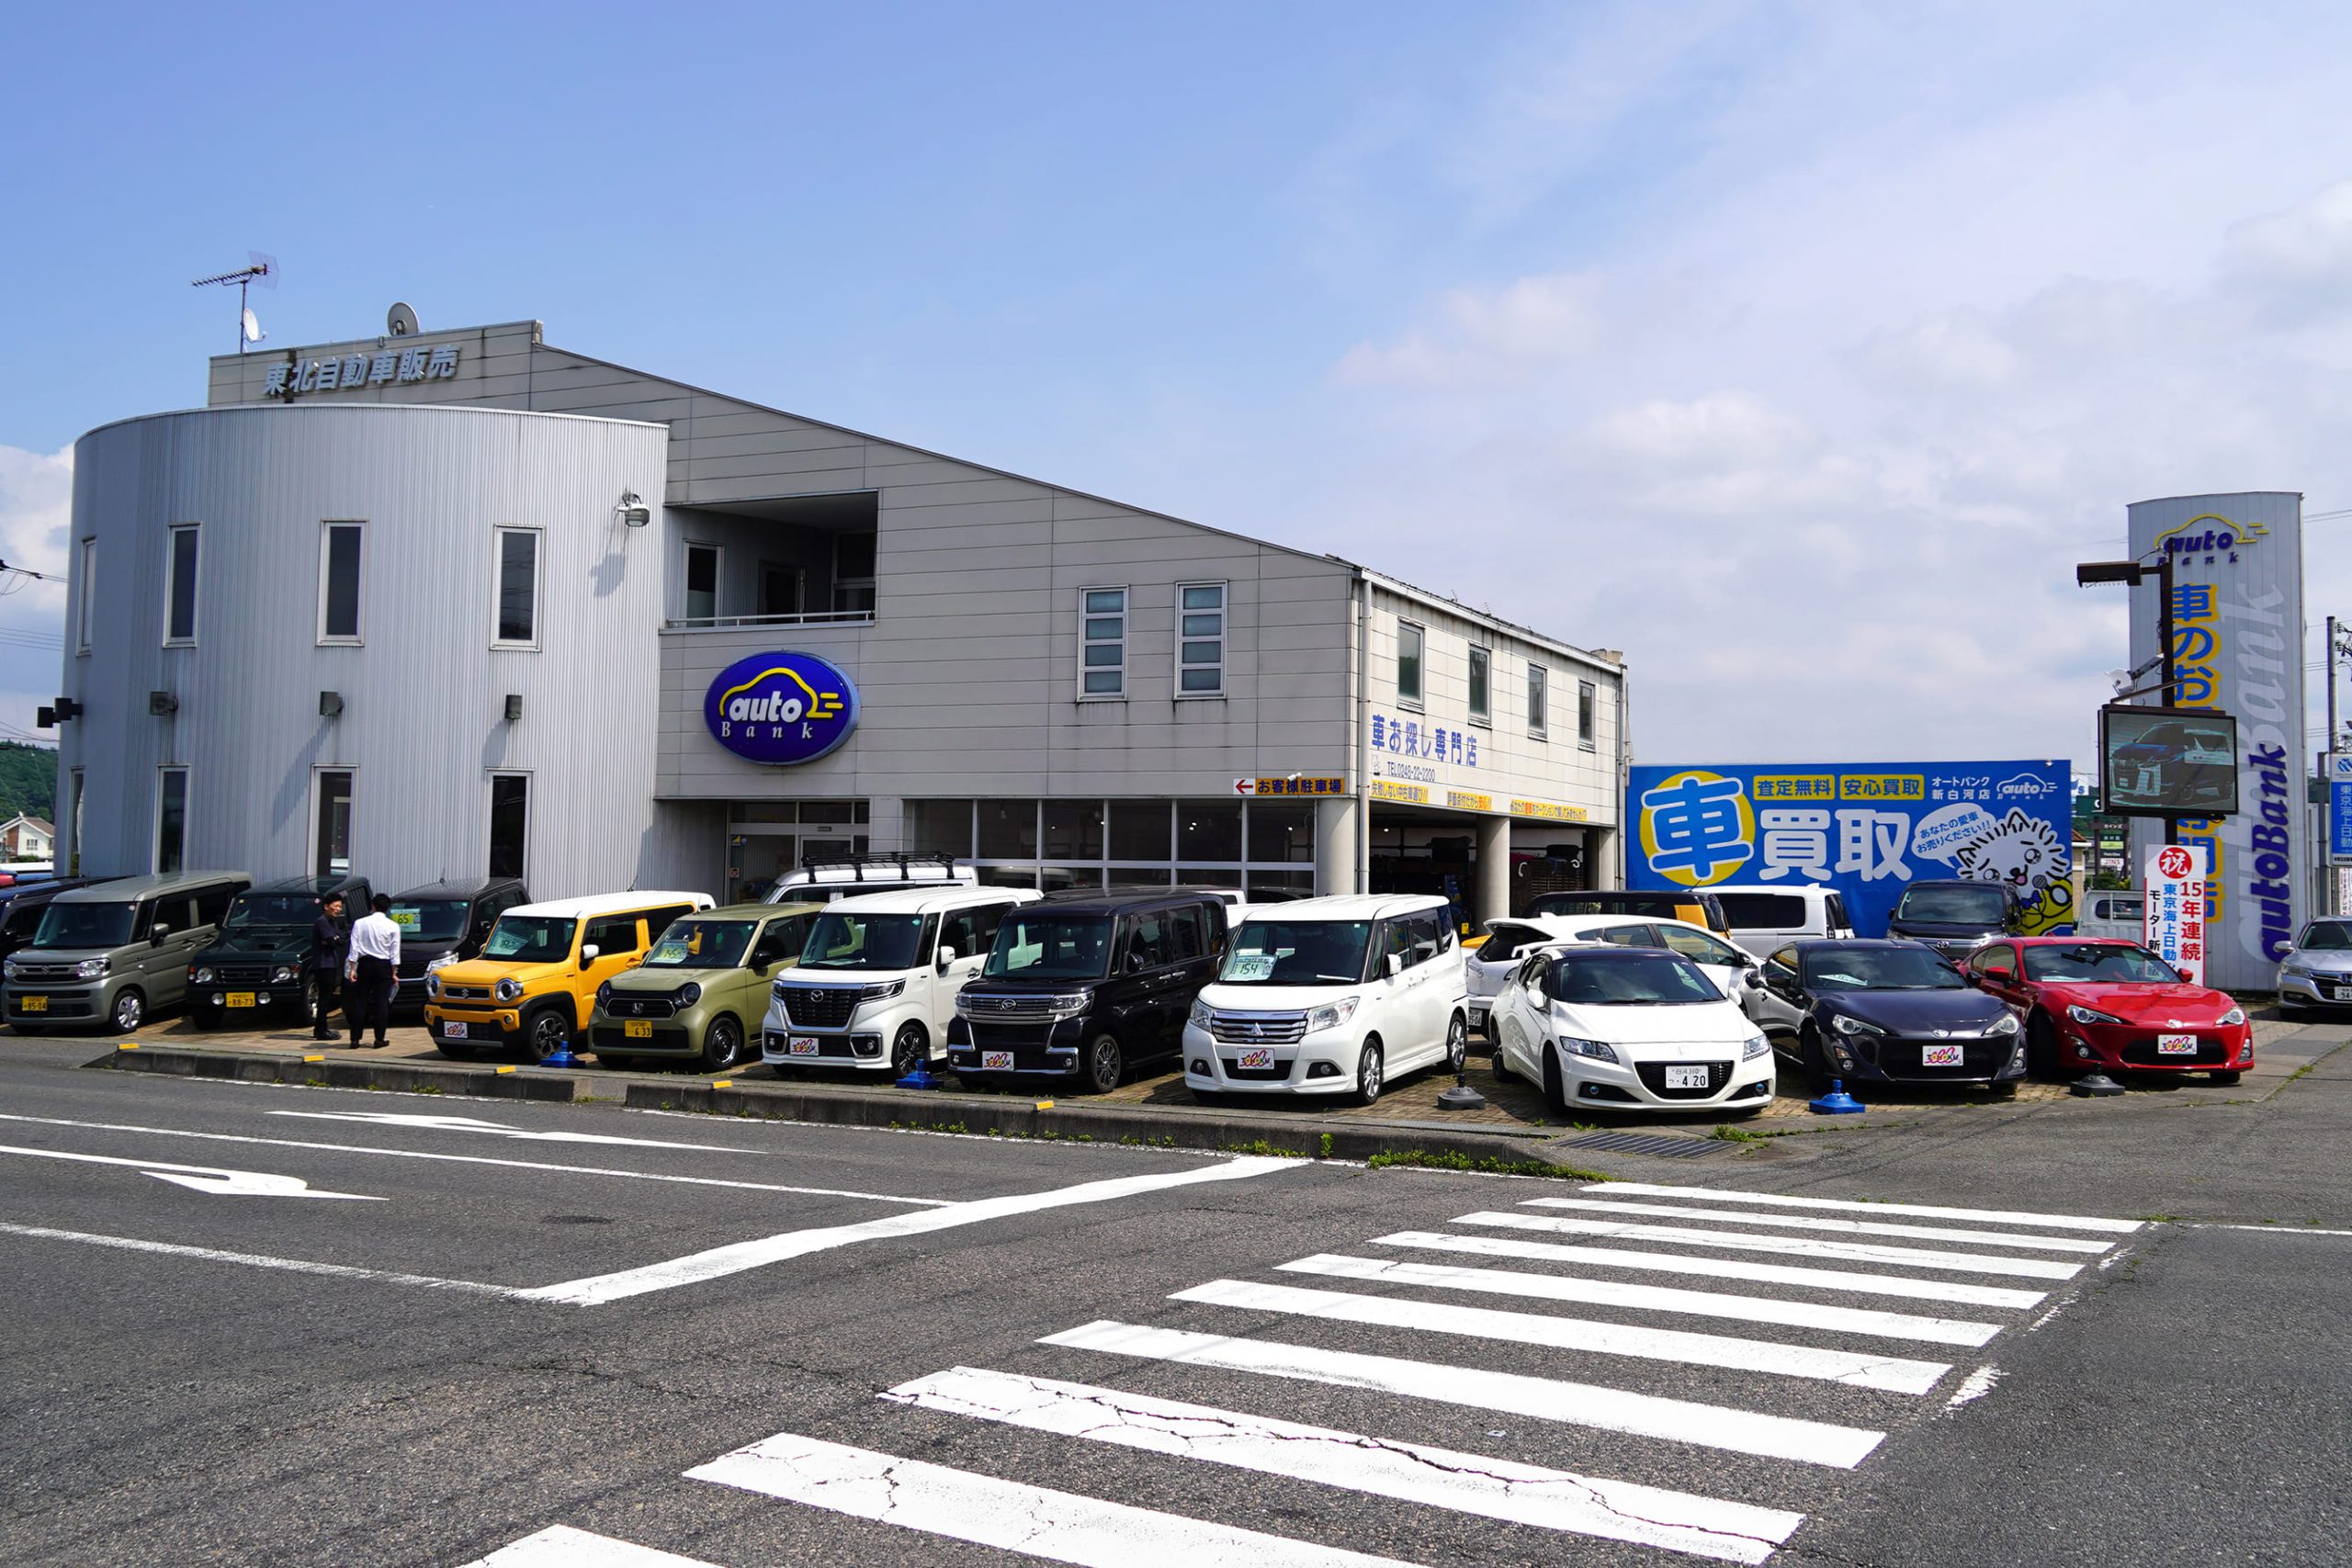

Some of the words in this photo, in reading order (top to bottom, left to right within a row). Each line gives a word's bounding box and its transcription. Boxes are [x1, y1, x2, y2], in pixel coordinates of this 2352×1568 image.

[263, 344, 459, 397] 東北自動車販売
[2164, 530, 2233, 551] auto
[729, 691, 802, 723] auto
[721, 721, 813, 739] Bank
[1372, 714, 1477, 767] 車お探し専門店
[1258, 779, 1342, 794] お客様駐車場
[1758, 780, 1831, 796] 査定無料
[1844, 779, 1921, 796] 安心買取
[1932, 776, 1990, 787] オートバンク
[2002, 782, 2041, 795] auto
[1932, 789, 1991, 800] 新白河店
[1916, 819, 1992, 854] お売りください!!
[1919, 811, 1980, 840] あなたの愛車
[2160, 851, 2188, 875] 祝
[2248, 742, 2291, 964] autoBank
[2163, 884, 2177, 968] 東京海上日動
[2180, 881, 2202, 961] 15年連続
[1240, 964, 1259, 975] 154
